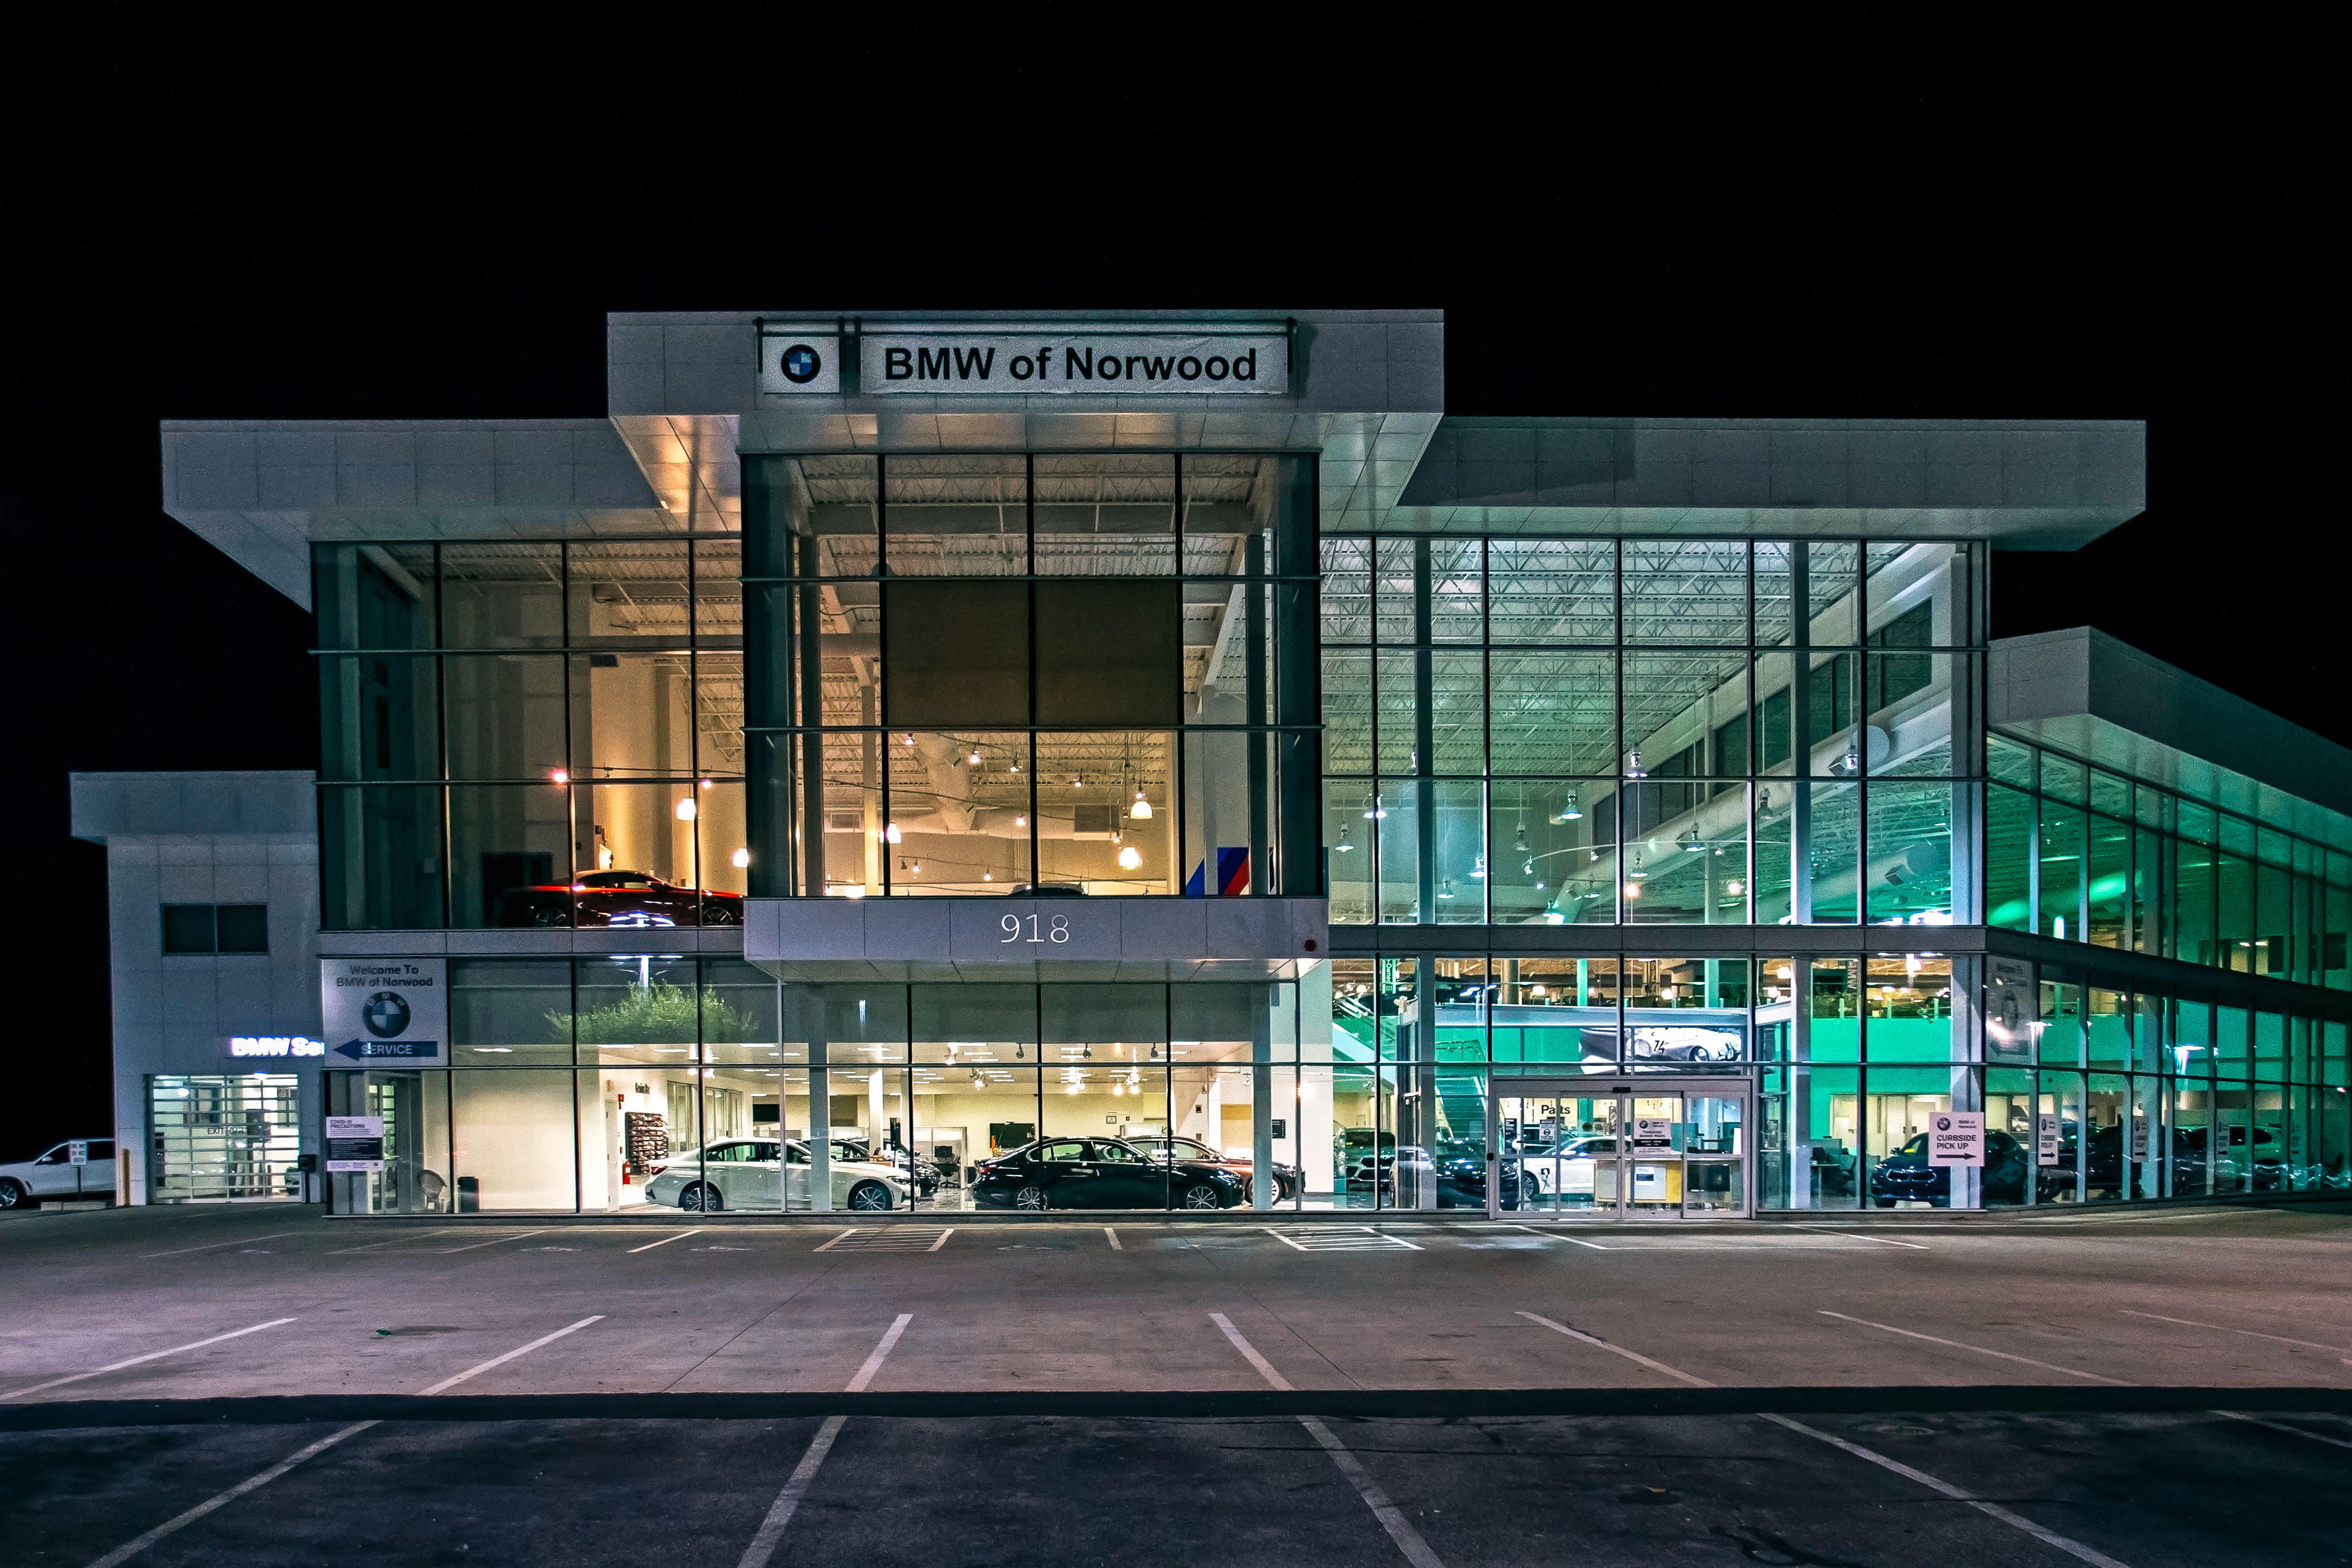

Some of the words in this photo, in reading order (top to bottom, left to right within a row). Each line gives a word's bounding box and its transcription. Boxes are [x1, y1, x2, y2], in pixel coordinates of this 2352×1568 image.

[885, 347, 996, 380] BMW
[1009, 347, 1052, 381] of
[1066, 347, 1256, 381] Norwood
[1001, 914, 1070, 943] 918
[349, 965, 401, 975] Welcome
[404, 964, 419, 974] To
[336, 977, 366, 987] BMW
[369, 977, 380, 987] of
[382, 976, 433, 986] Norwood
[232, 1036, 291, 1057] BMW
[361, 1044, 413, 1055] SERVICE
[1653, 1040, 1665, 1053] 74
[1541, 1105, 1570, 1114] Pats
